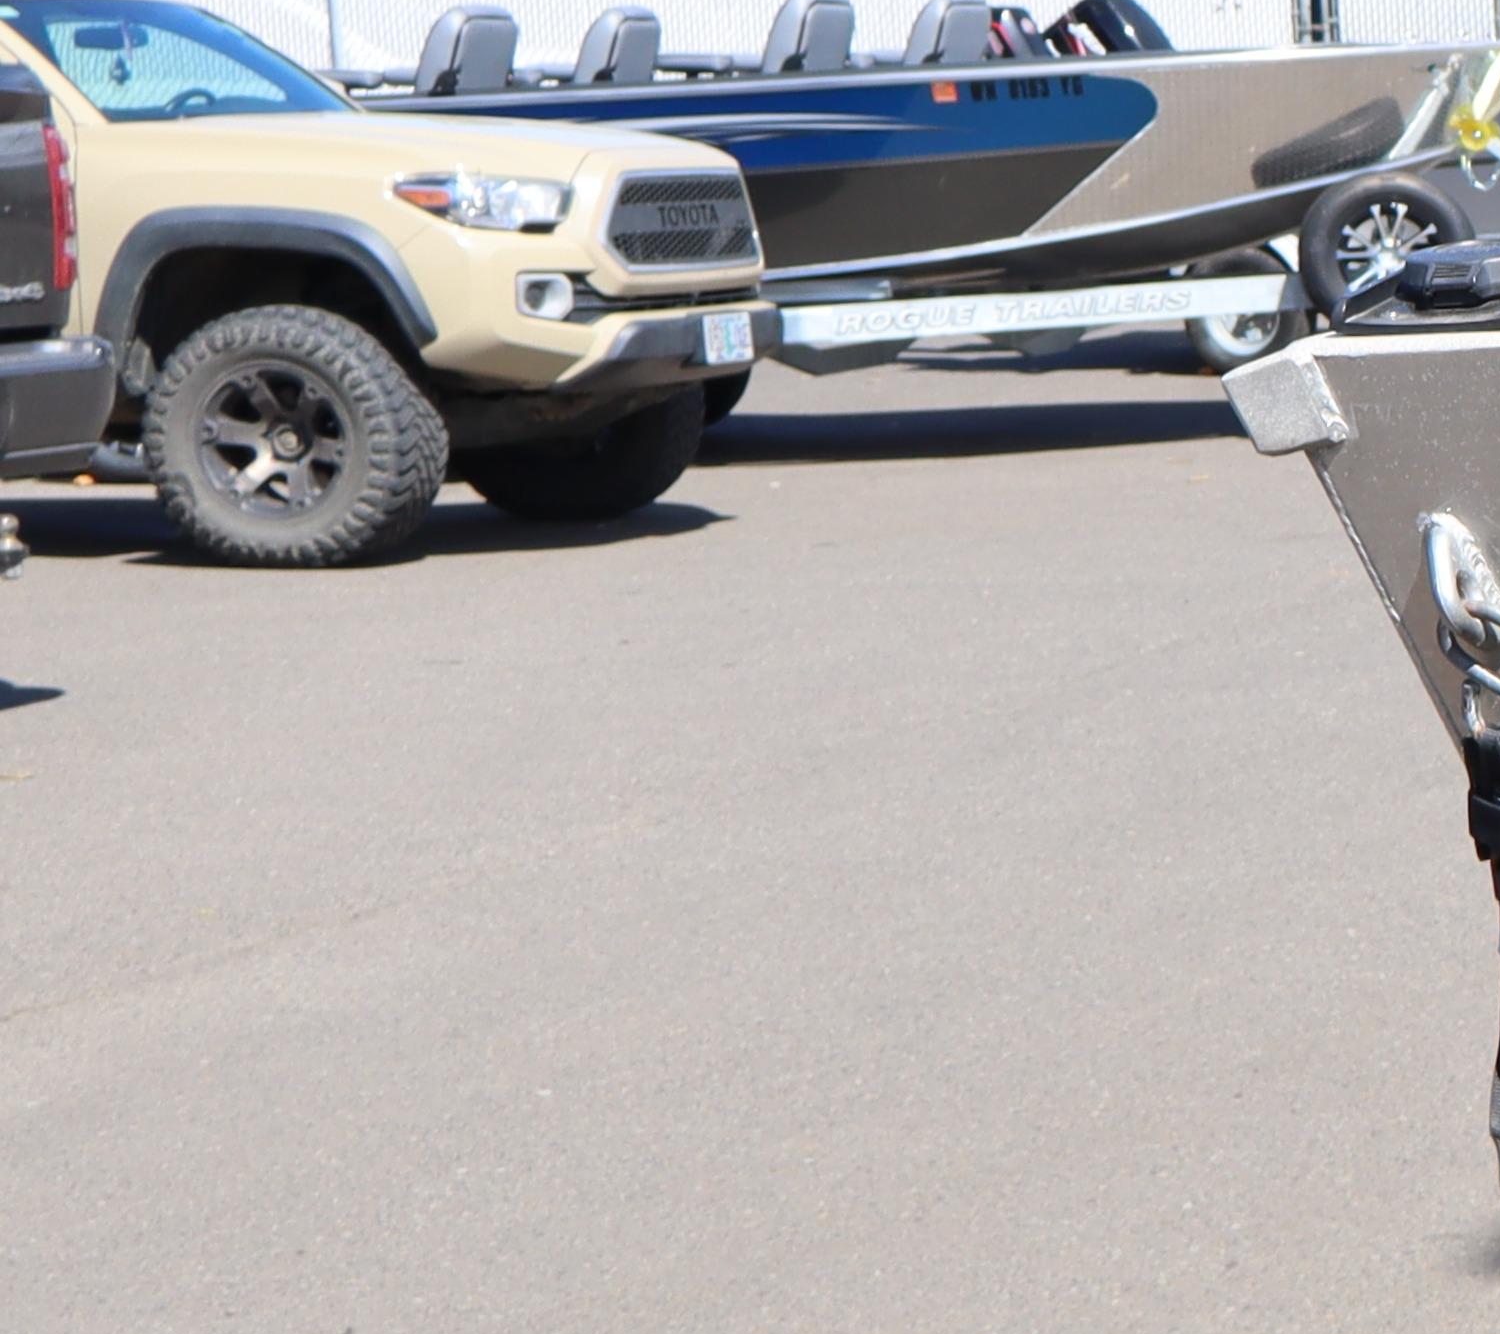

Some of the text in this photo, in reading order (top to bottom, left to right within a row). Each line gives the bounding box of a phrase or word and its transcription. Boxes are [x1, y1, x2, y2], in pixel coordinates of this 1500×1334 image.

[657, 204, 720, 227] TOYOTA
[834, 288, 1192, 336] ROGUE TRAILERS
